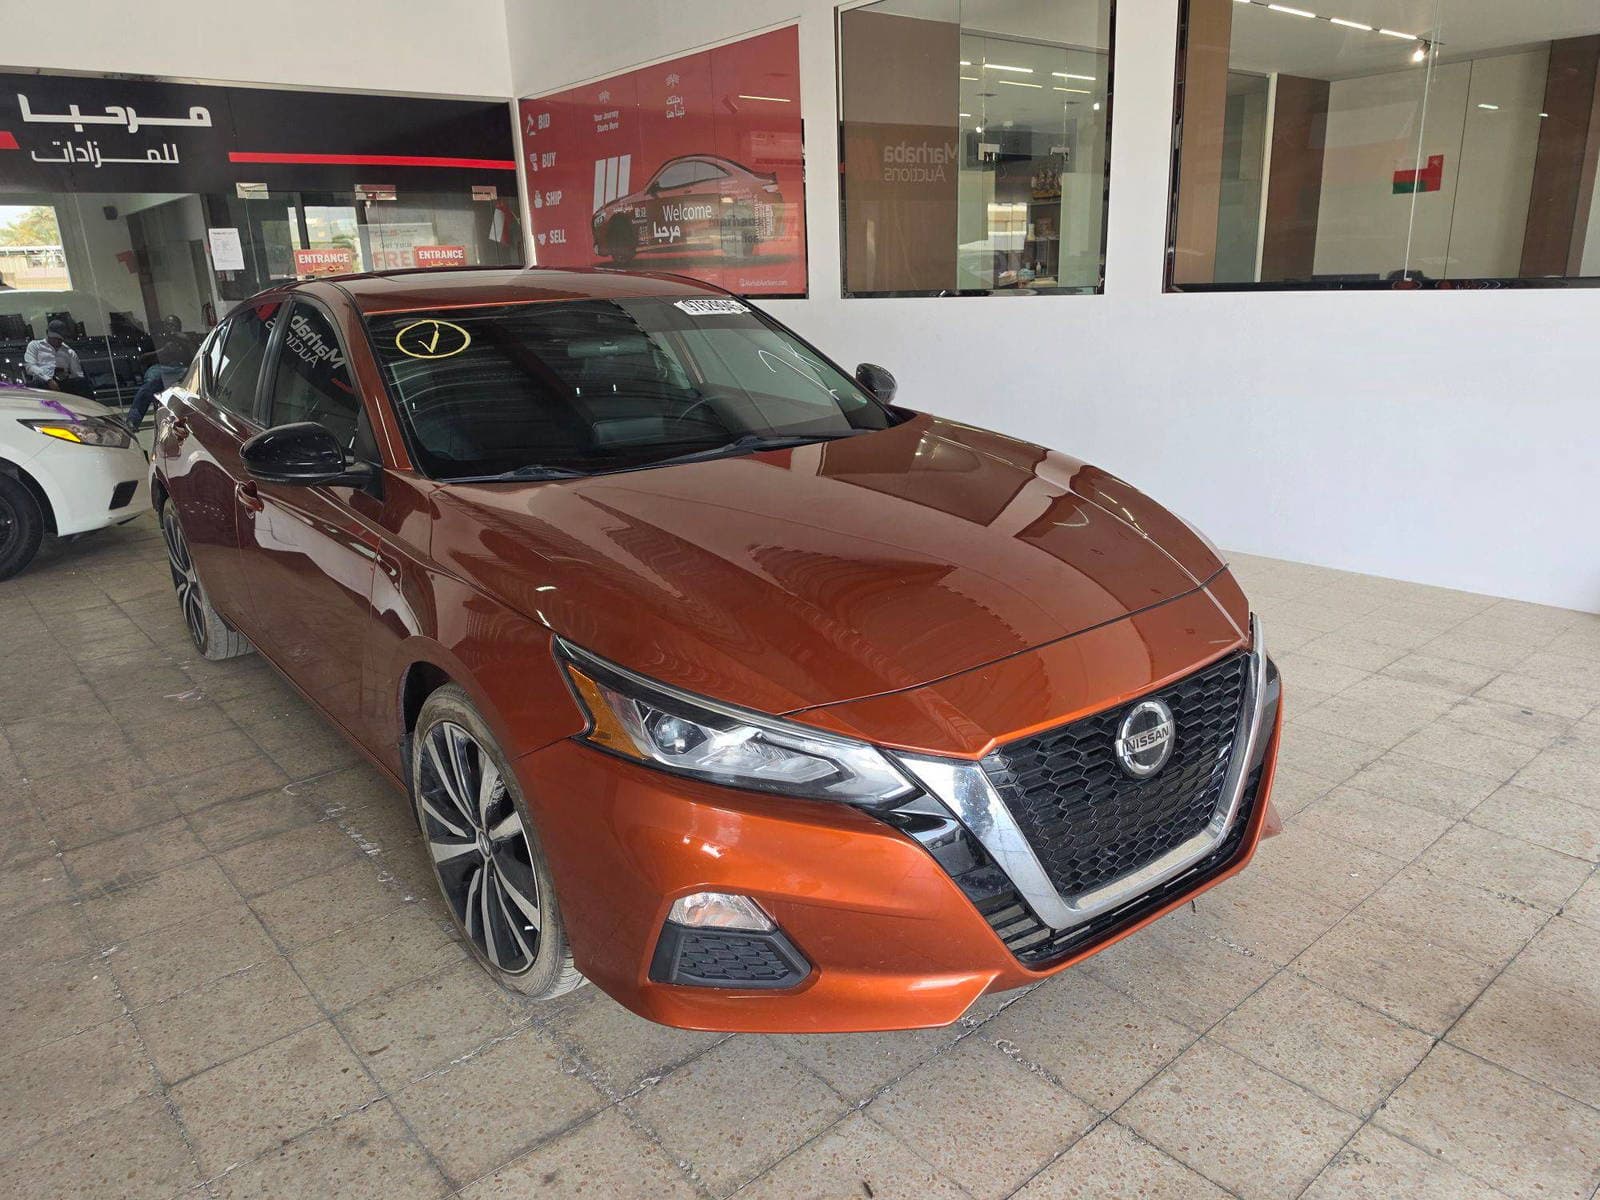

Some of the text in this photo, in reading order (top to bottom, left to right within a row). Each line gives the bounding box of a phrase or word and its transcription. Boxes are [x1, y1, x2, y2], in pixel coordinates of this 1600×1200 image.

[17, 93, 212, 134] مرحبا
[538, 113, 550, 129] BID
[31, 141, 179, 168] للمزادات
[542, 152, 557, 168] BUY
[546, 191, 562, 206] SHIP
[663, 205, 712, 222] Welcome
[549, 229, 566, 244] SELL
[653, 221, 681, 243] مرحبا
[299, 253, 350, 264] ENTRANCE
[373, 251, 413, 268] FRE
[419, 249, 464, 260] ENTRANCE
[1125, 726, 1169, 751] NISSAN
